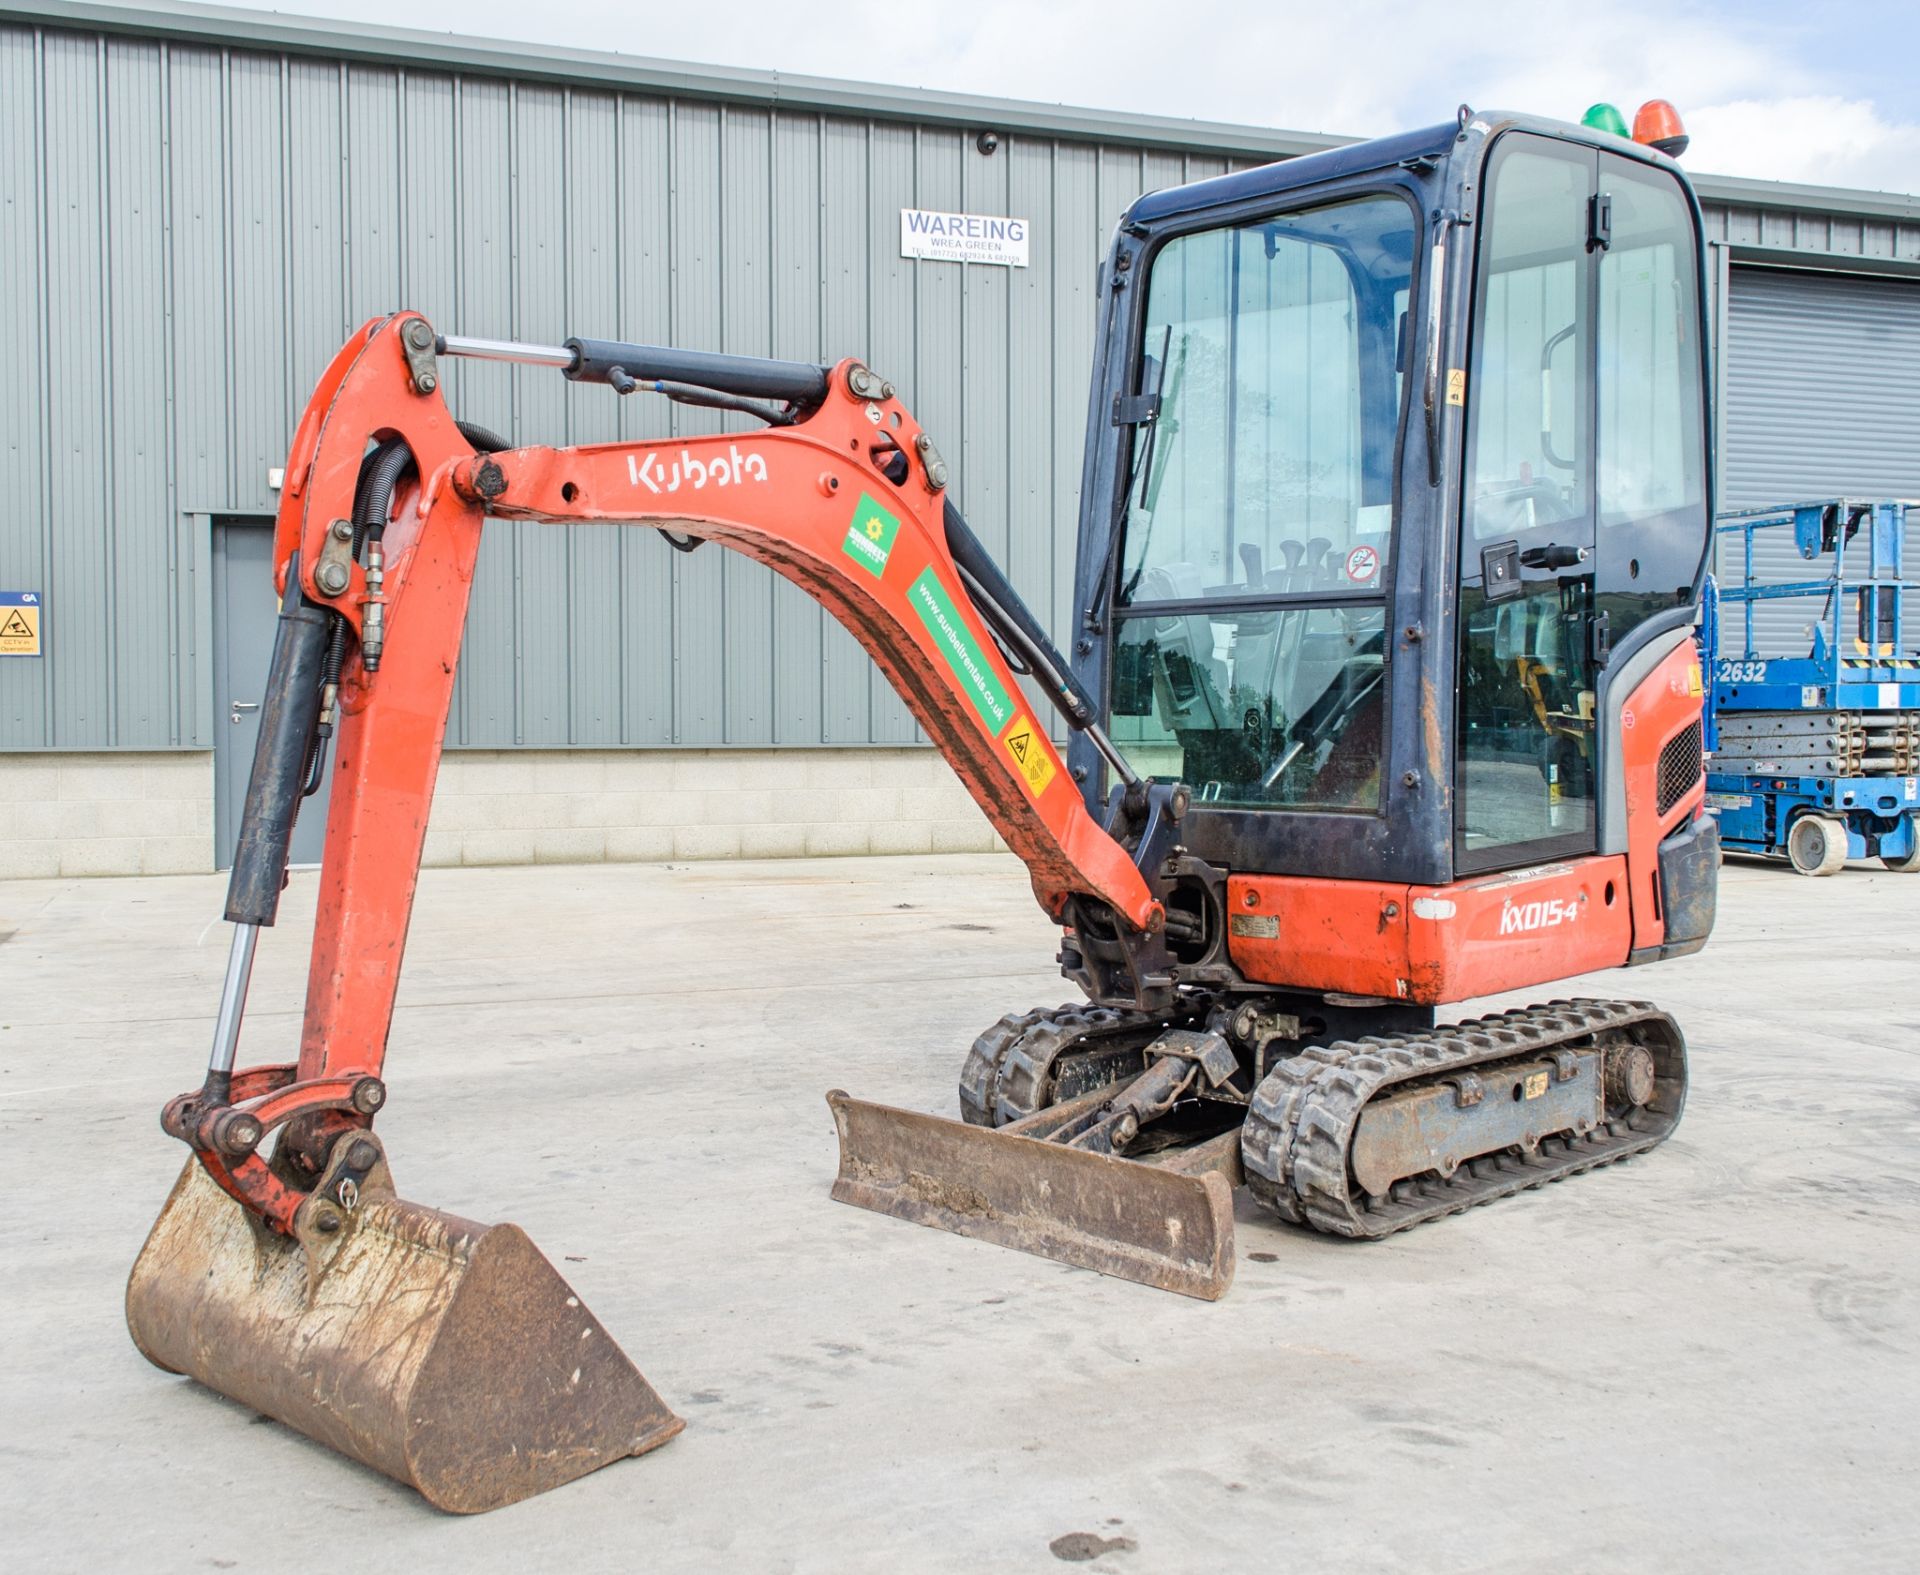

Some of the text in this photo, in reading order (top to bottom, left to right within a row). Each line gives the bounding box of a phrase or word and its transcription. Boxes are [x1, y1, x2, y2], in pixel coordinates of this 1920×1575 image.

[908, 213, 1024, 242] WAREING
[931, 238, 1002, 251] WREA GREEN
[627, 445, 768, 494] Kubota
[22, 593, 37, 602] GA
[919, 583, 1004, 721] www.sunbeltrentals.co.uk
